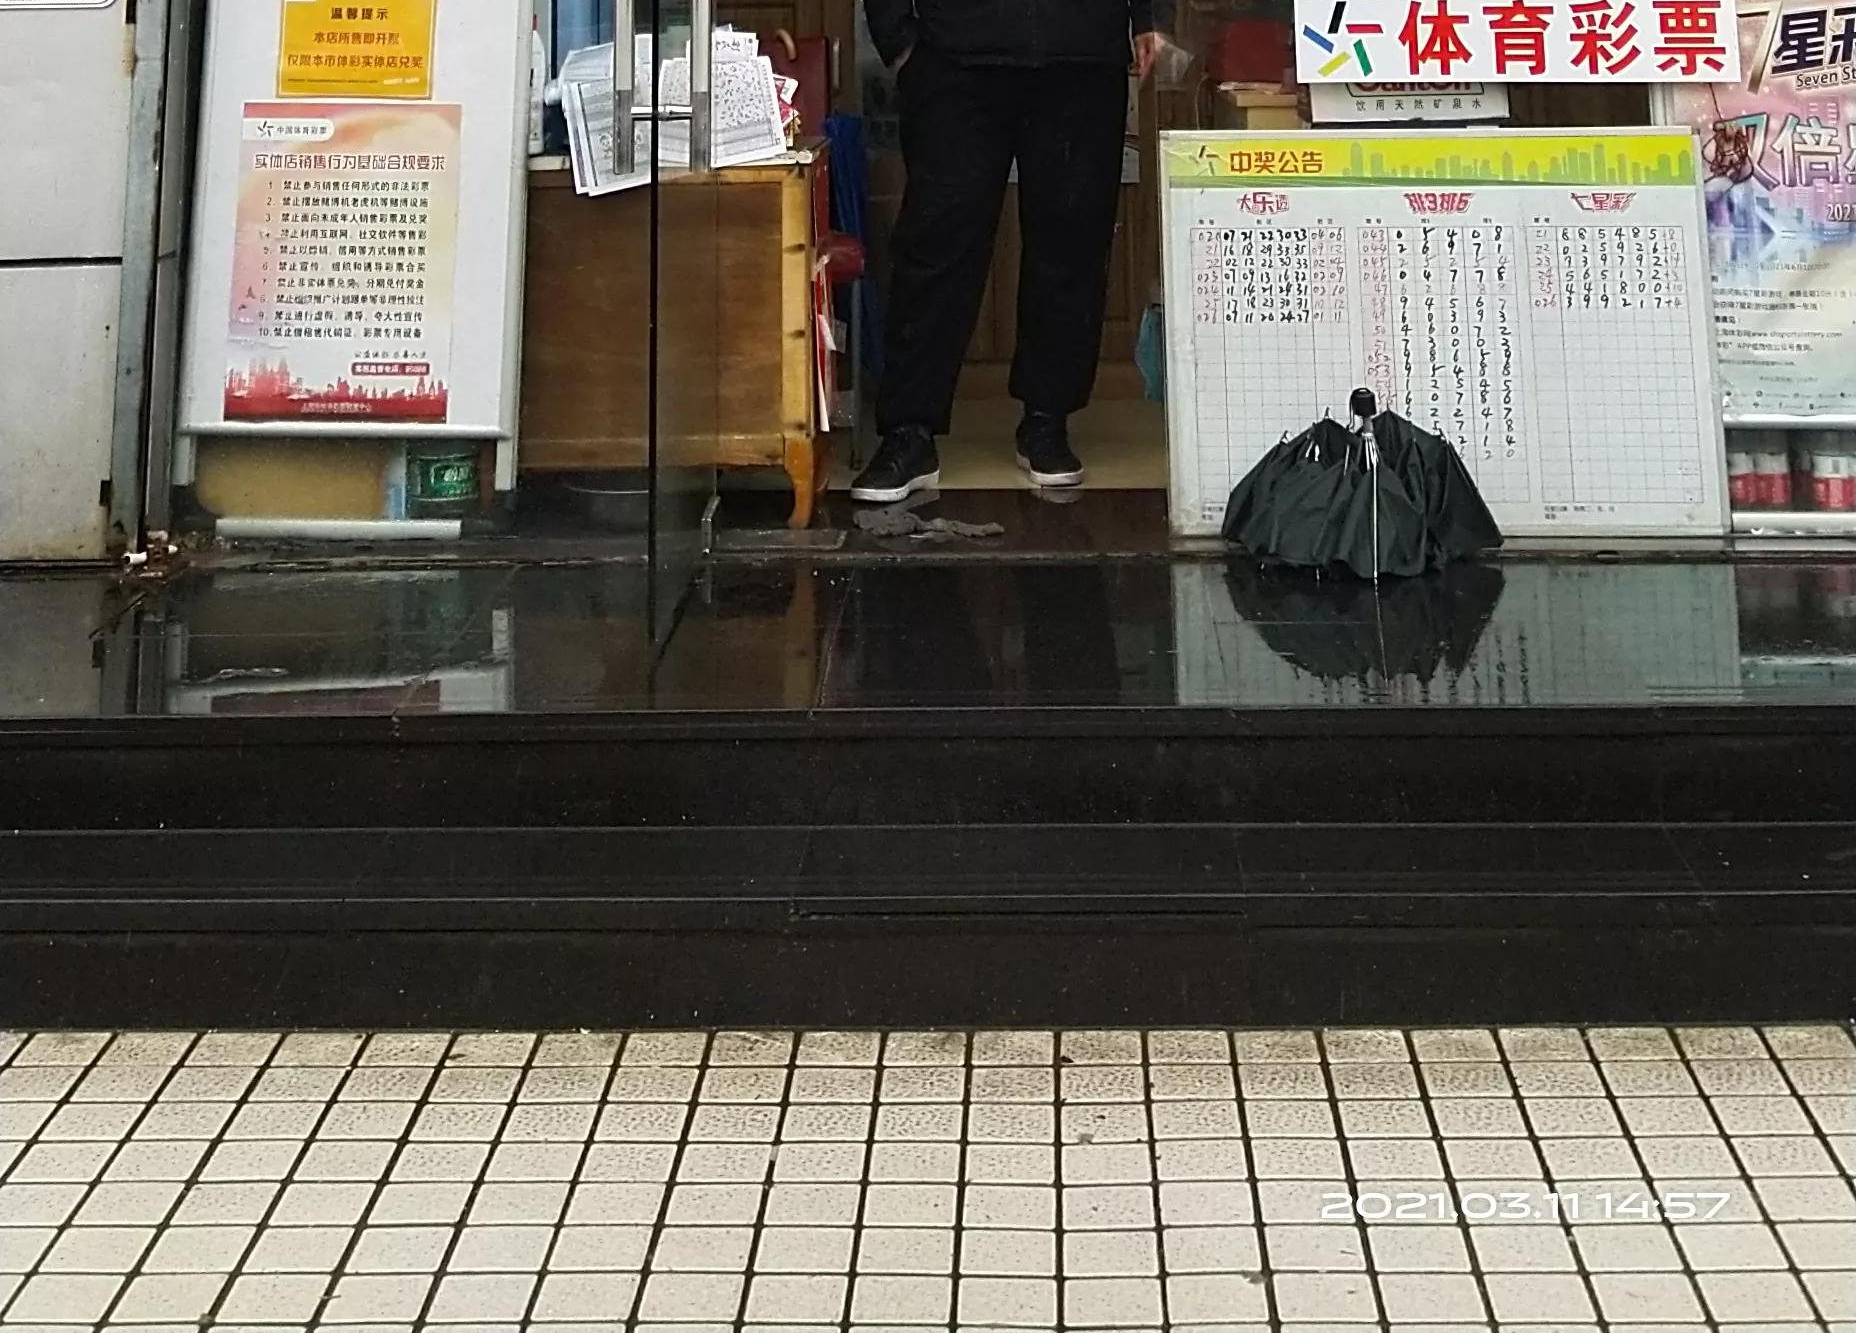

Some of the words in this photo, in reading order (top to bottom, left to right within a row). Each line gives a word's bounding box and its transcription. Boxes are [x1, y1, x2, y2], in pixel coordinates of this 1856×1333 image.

[331, 7, 389, 20] 温馨提示
[314, 32, 400, 45] 本店所售即开票
[1398, 0, 1727, 75] 体育彩票
[287, 54, 424, 68] 仅限本市体彩实体店兑奖
[1797, 69, 1838, 88] Seven
[1356, 98, 1482, 111] 饮用天然矿泉水
[277, 126, 327, 135] 中国体育彩票
[255, 154, 445, 171] 实体店销售行为基础合规要求
[1230, 151, 1323, 173] 中奖公告
[1238, 192, 1289, 215] 大乐透
[1571, 192, 1637, 212] 七星彩
[1260, 245, 1273, 256] 29
[1294, 245, 1306, 256] 35
[1226, 258, 1238, 267] 02
[1279, 258, 1291, 267] 30
[1224, 270, 1236, 283] 07
[1260, 272, 1271, 282] 13
[1262, 298, 1274, 307] 23
[1226, 310, 1238, 323] 07
